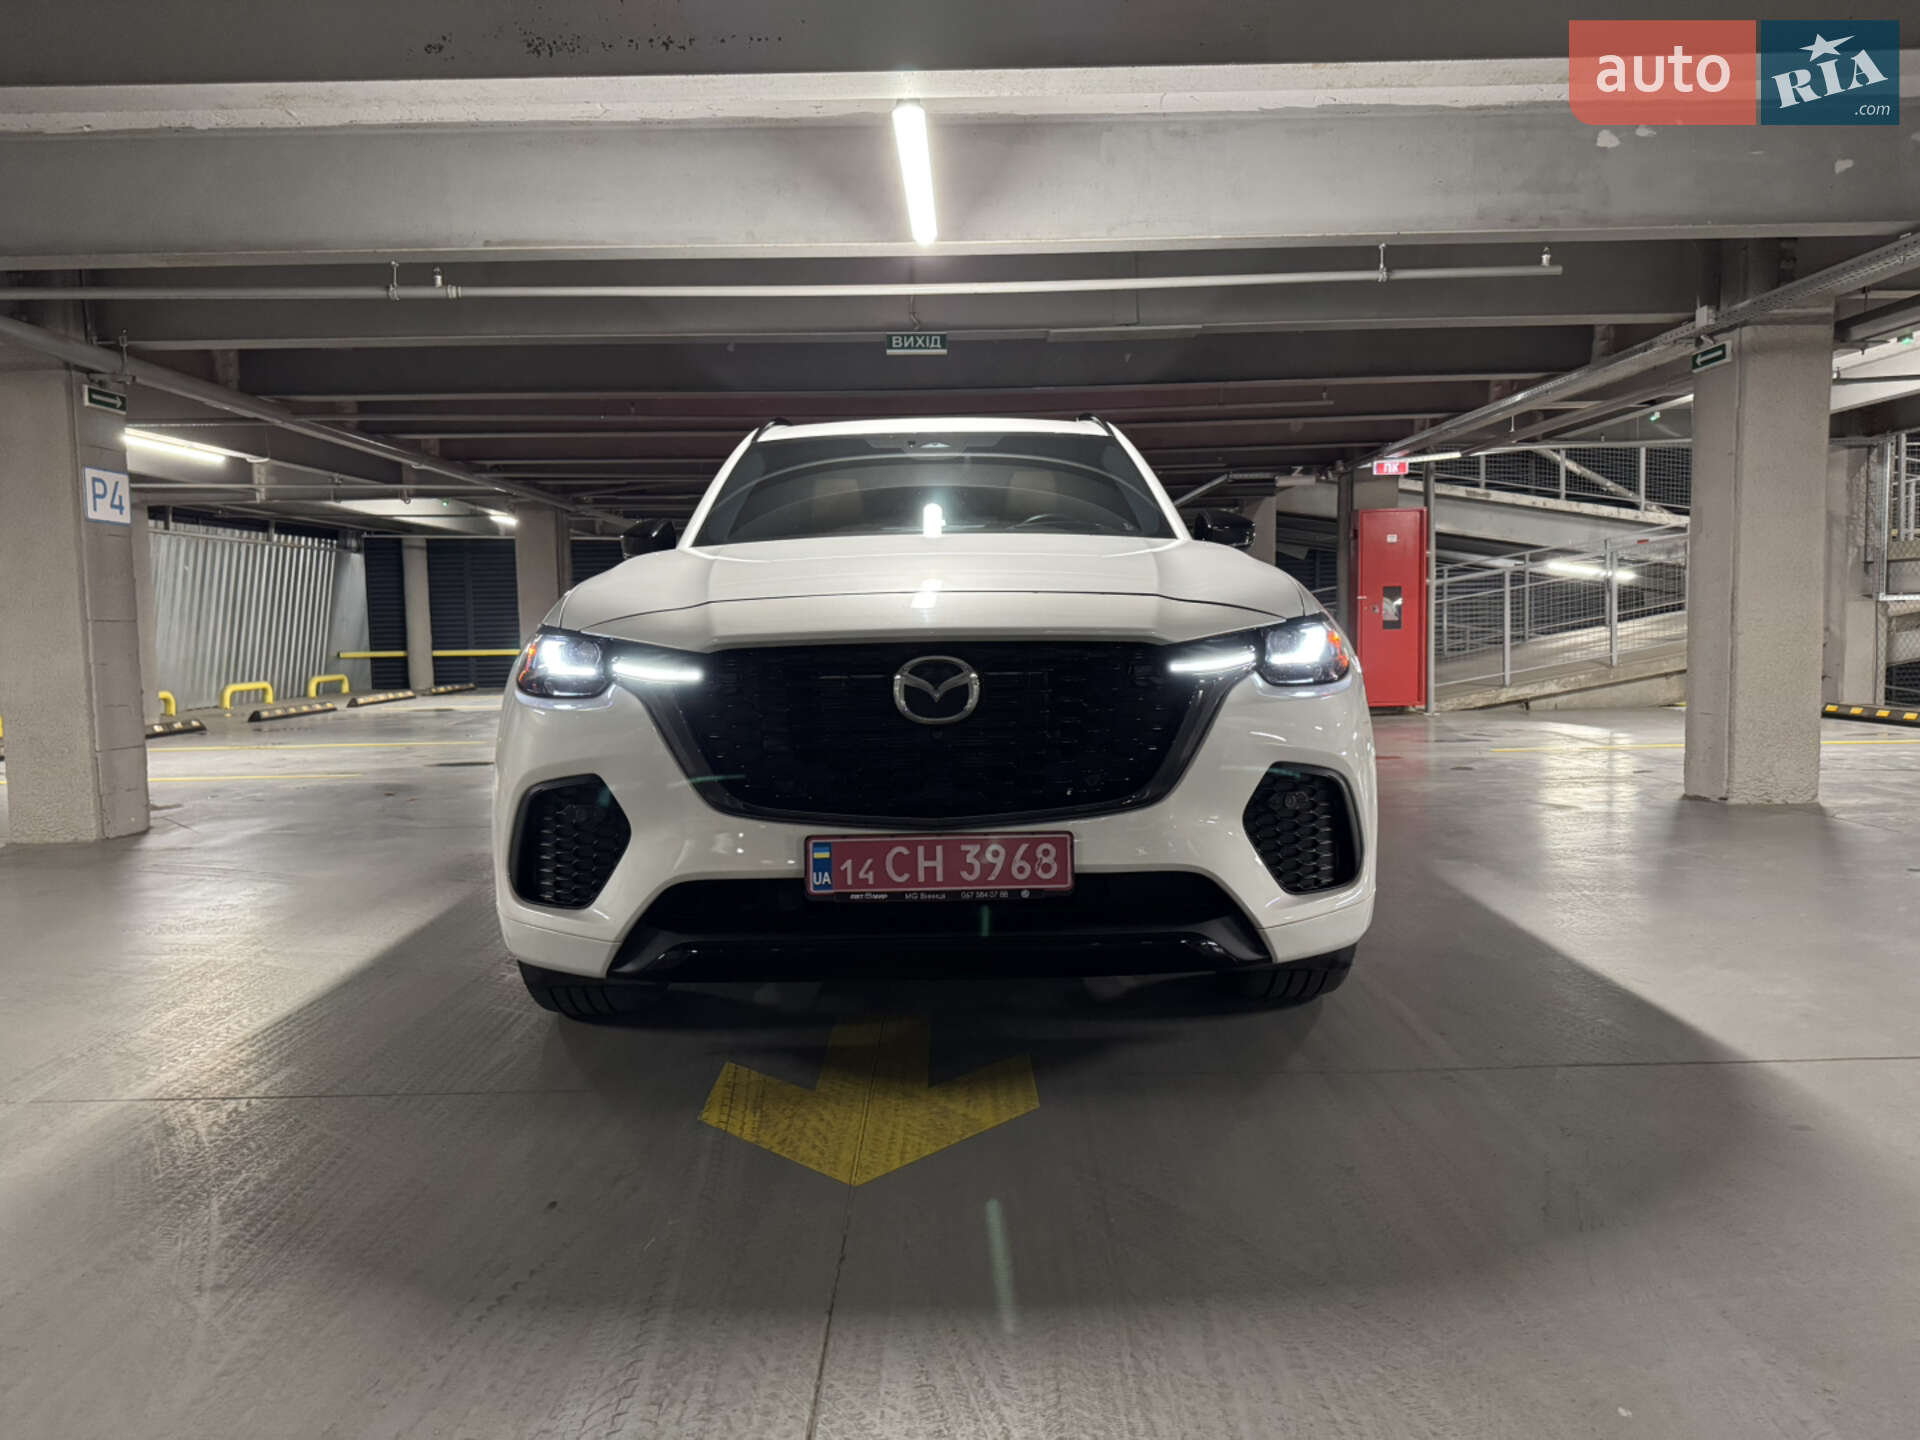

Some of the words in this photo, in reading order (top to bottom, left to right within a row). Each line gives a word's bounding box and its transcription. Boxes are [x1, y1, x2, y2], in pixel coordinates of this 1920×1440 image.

[891, 335, 942, 348] ВИХІД
[92, 476, 125, 515] P4
[840, 858, 875, 886] 14
[885, 845, 944, 884] CH
[959, 843, 1058, 881] 3968
[813, 871, 832, 886] UA
